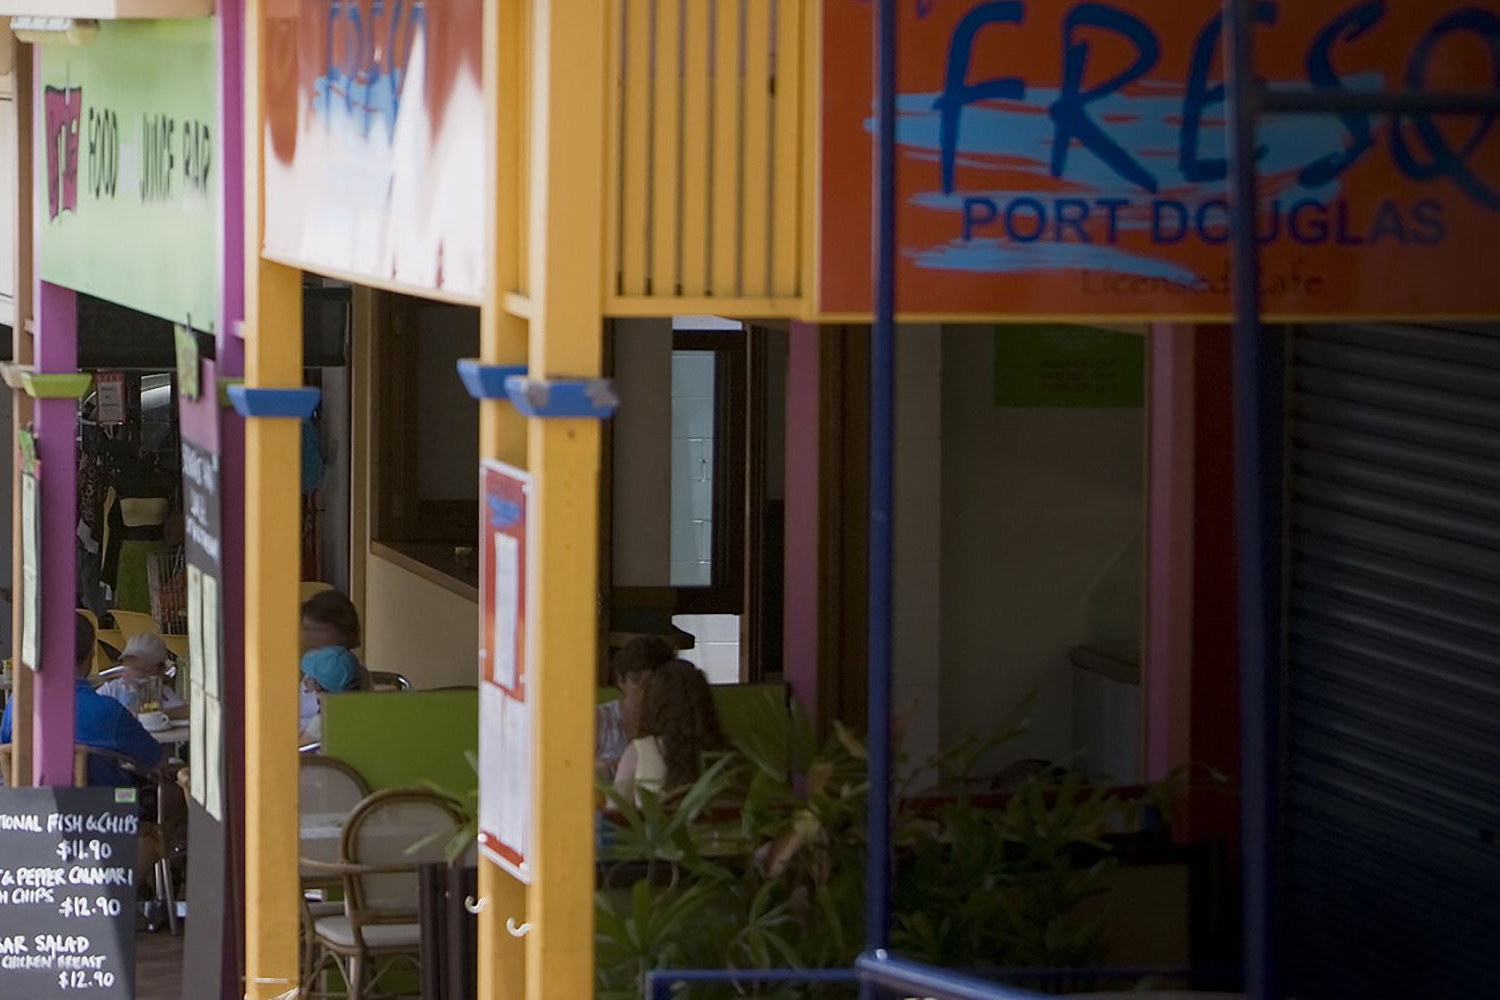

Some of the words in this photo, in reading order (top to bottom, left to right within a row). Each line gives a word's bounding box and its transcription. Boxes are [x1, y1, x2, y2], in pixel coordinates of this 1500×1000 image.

[961, 197, 1129, 244] PORT
[1252, 257, 1323, 296] afe
[47, 813, 83, 833] FISH
[56, 839, 112, 861] $11.90
[2, 871, 16, 887] &
[12, 888, 55, 905] CHIPS
[58, 896, 121, 918] $12.90
[34, 934, 90, 956] SALAD
[2, 955, 52, 969] CHICKEN
[58, 971, 115, 990] $12.90
